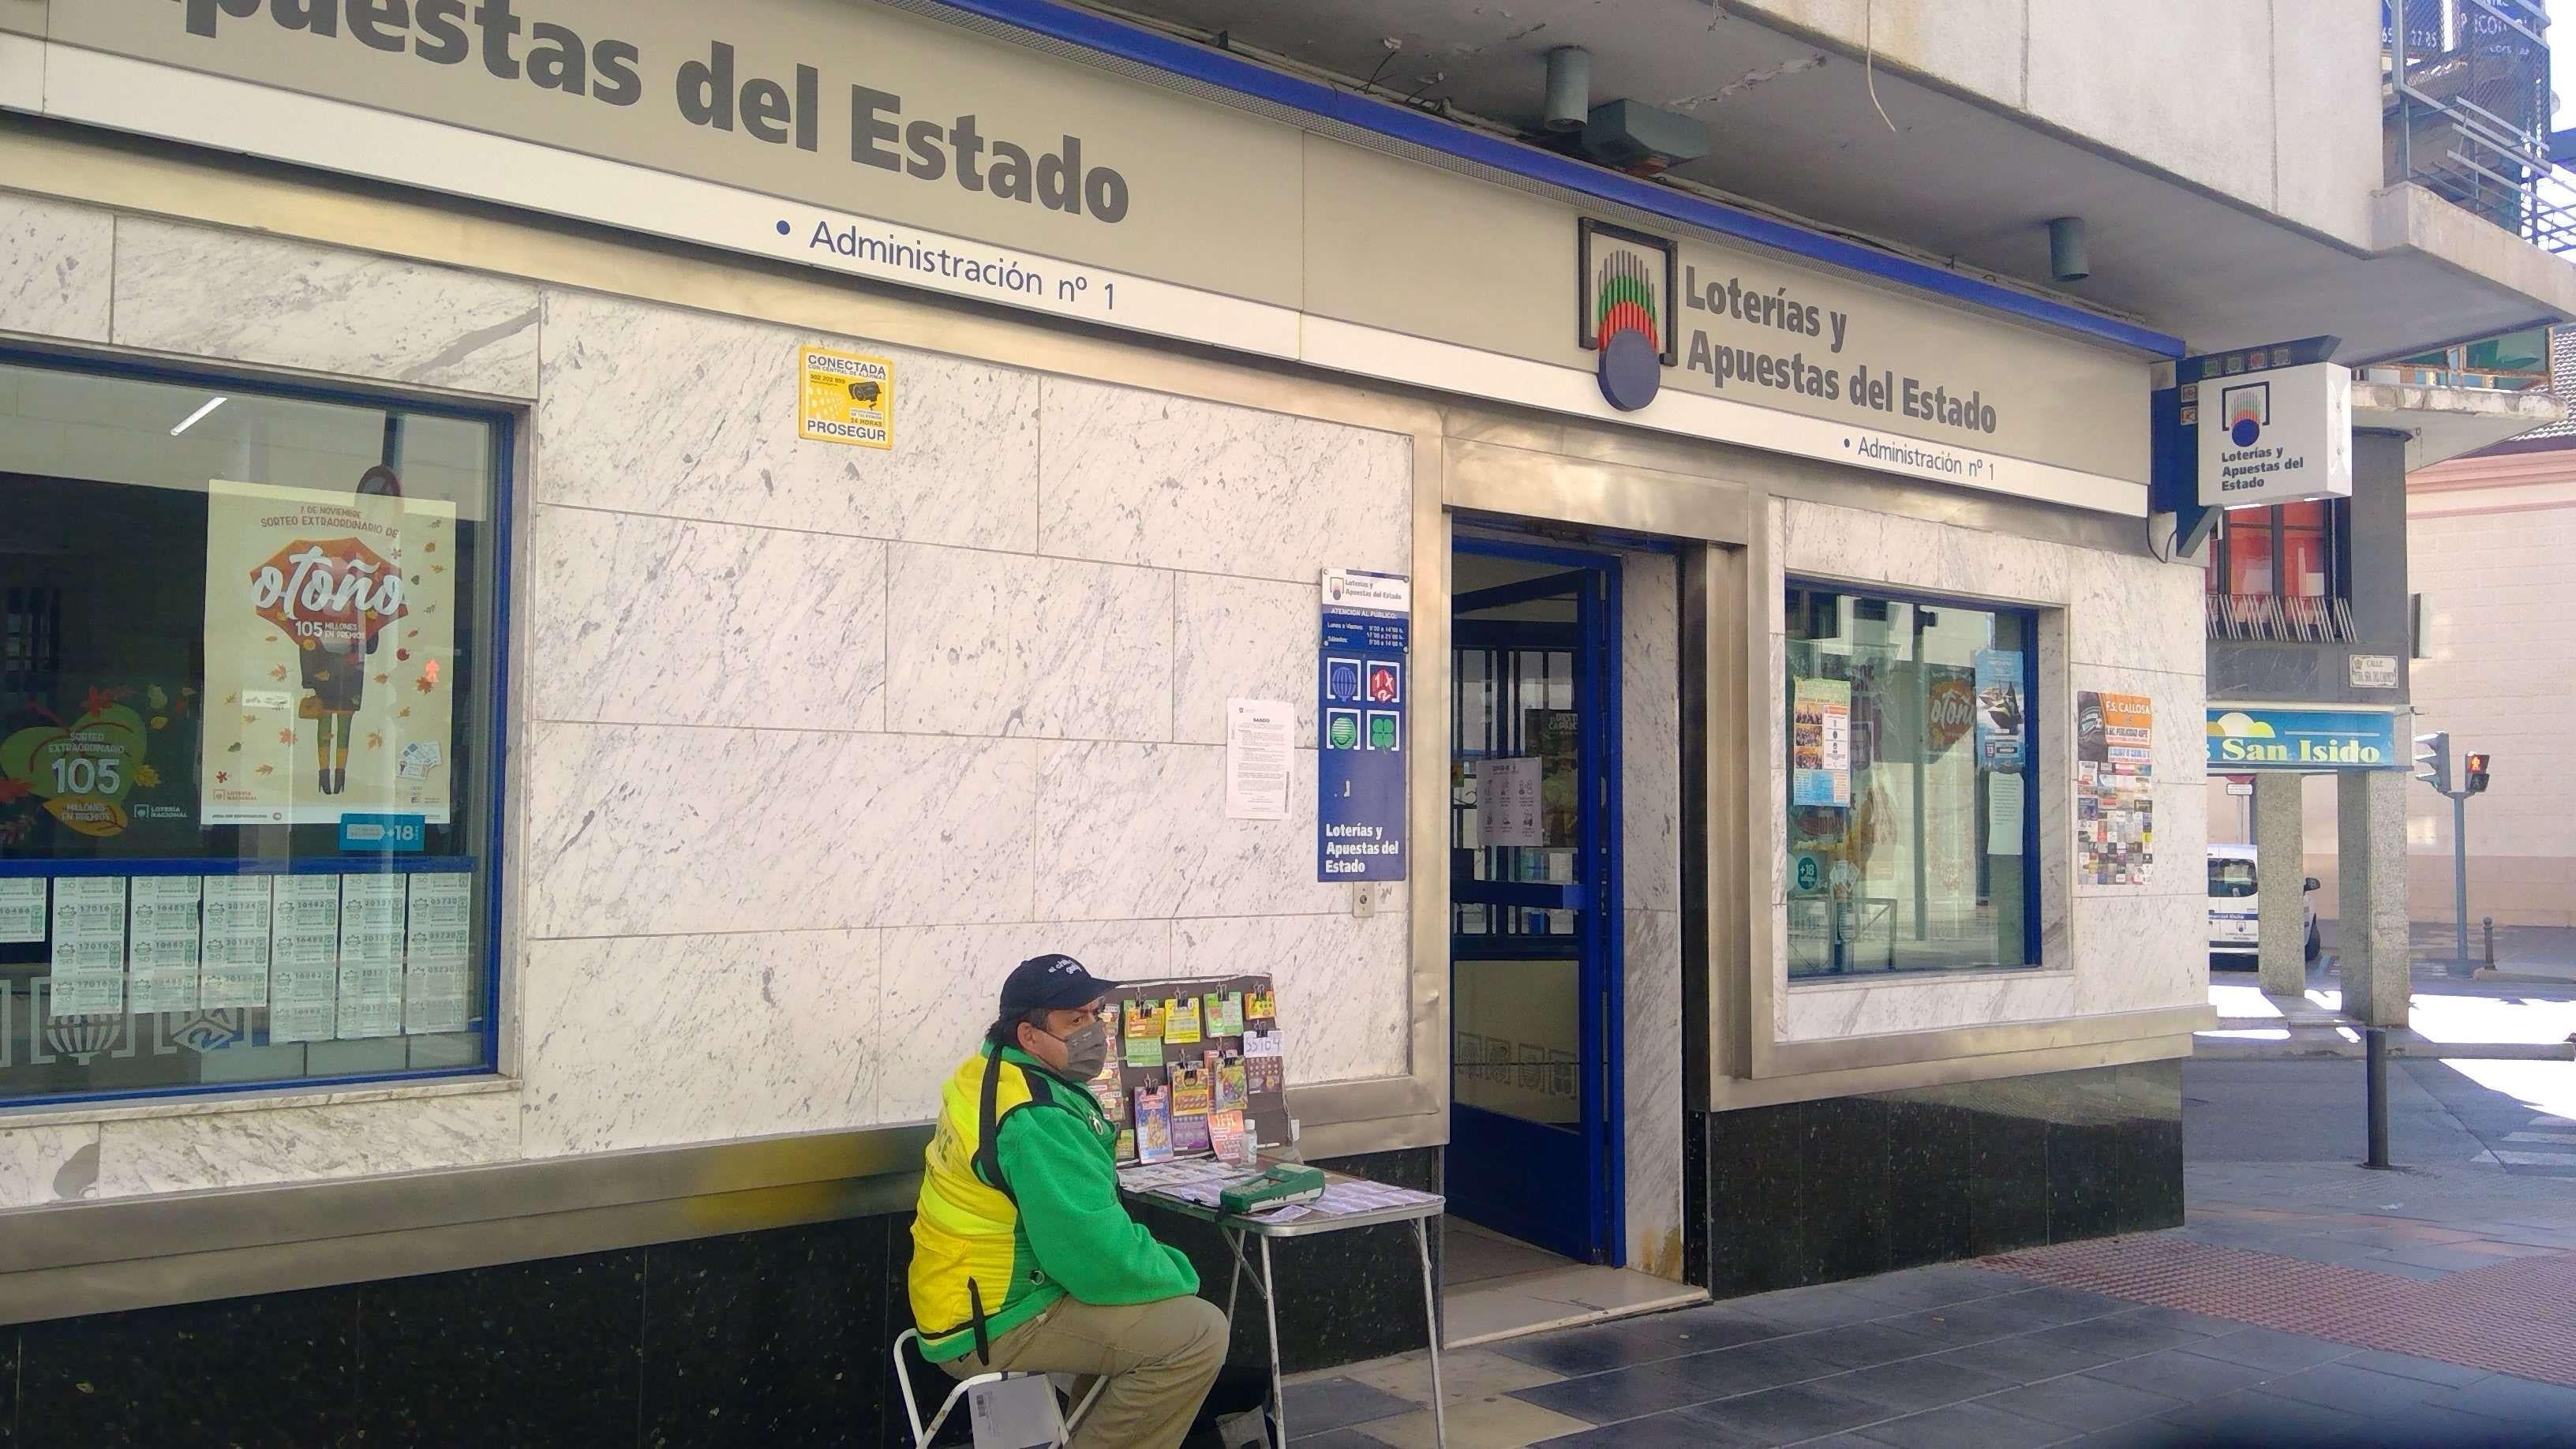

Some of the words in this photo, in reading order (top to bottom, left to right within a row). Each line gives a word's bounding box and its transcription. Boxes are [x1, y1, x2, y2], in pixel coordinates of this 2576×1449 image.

[168, 0, 642, 106] puestas
[676, 40, 818, 152] del
[852, 84, 1129, 223] Estado
[810, 221, 1043, 296] Administración
[1059, 276, 1088, 302] nº
[1104, 283, 1114, 310] 1
[1687, 265, 1821, 337] Loterías
[1830, 311, 1848, 354] y
[808, 355, 886, 376] CONECTADA
[1687, 329, 1840, 401] Apuestas
[1850, 365, 1893, 413] del
[1903, 377, 1997, 433] Estado
[807, 420, 886, 441] PROSEGUR
[1859, 436, 1962, 475] Administración
[1989, 463, 1995, 481] 1
[2222, 446, 2272, 462] Loterías
[2276, 447, 2283, 459] y
[2222, 462, 2280, 478] Apuestas
[2285, 457, 2304, 470] del
[2222, 477, 2265, 492] Estado
[307, 506, 317, 515] DE
[320, 507, 362, 519] NOVIEMBRE
[260, 517, 298, 528] SORTEO
[301, 517, 384, 534] EXTRAORDINARIO
[385, 527, 399, 538] DE
[252, 545, 409, 620] otoño
[295, 621, 323, 638] 105
[70, 732, 104, 742] SORTEO
[2222, 738, 2289, 762] San
[2299, 738, 2381, 764] Isido
[52, 758, 121, 794] 105
[1326, 823, 1373, 837] Loterías
[1376, 826, 1383, 841] y
[1327, 841, 1380, 859] Apuestas
[1382, 841, 1399, 855] del
[1325, 859, 1366, 874] Estado
